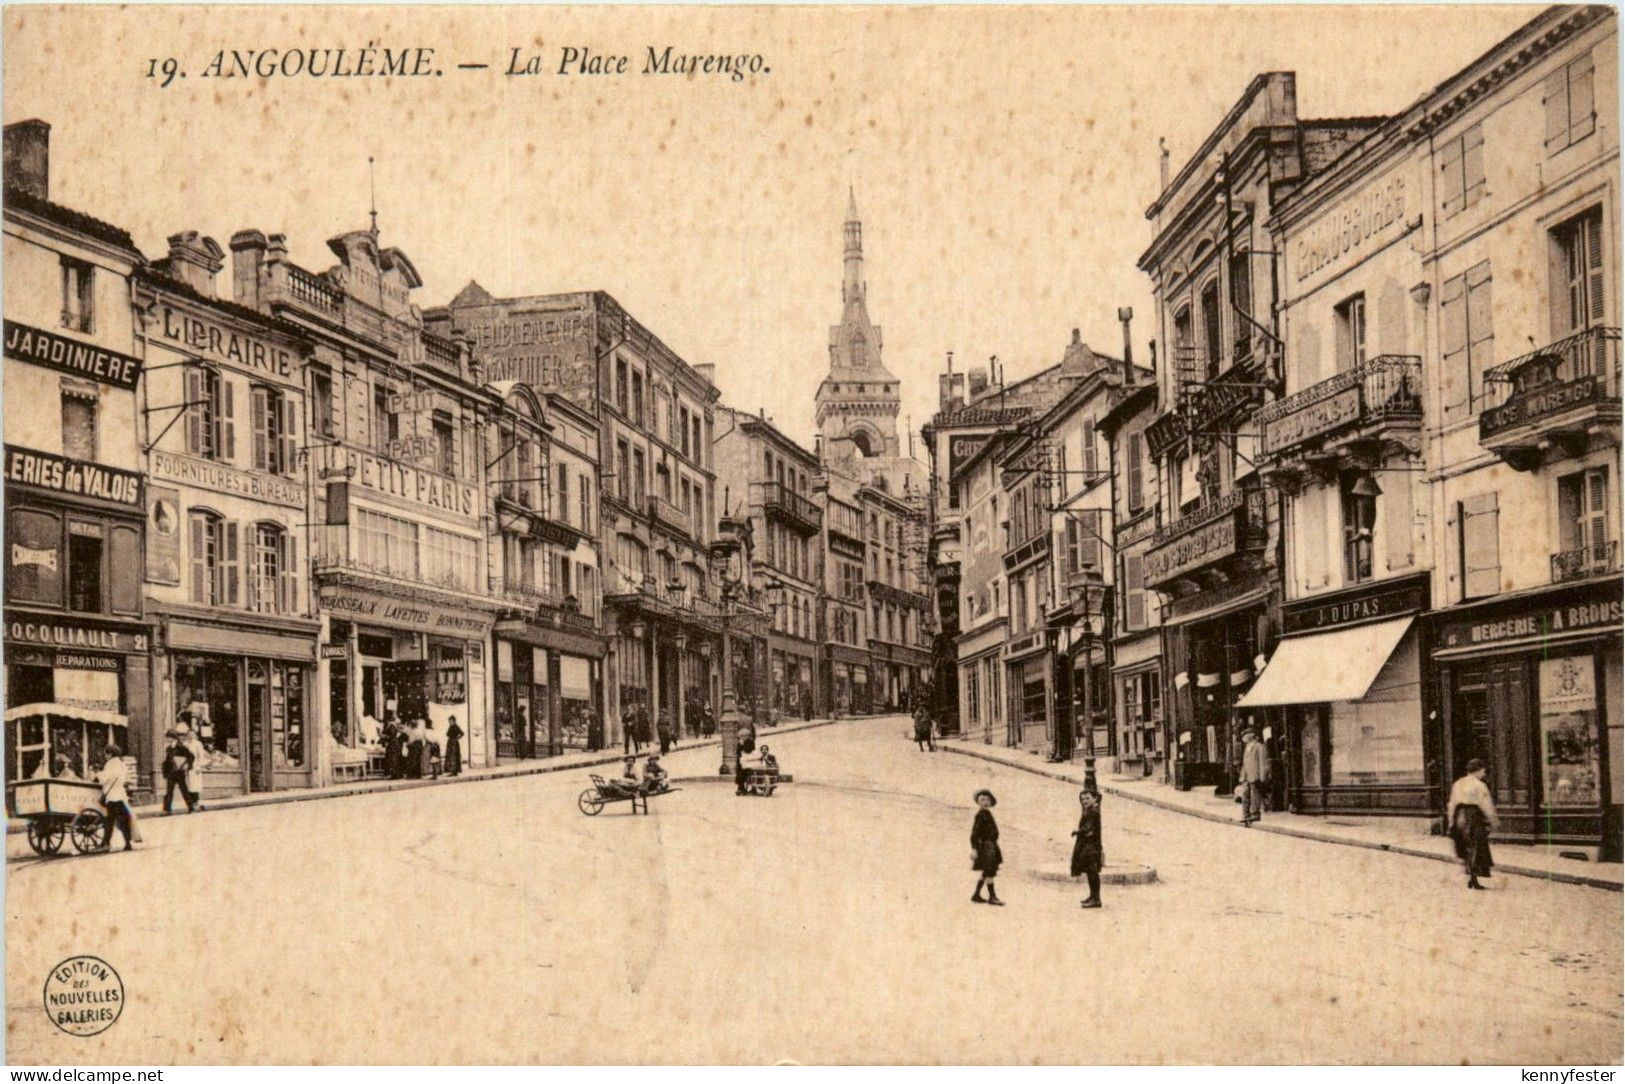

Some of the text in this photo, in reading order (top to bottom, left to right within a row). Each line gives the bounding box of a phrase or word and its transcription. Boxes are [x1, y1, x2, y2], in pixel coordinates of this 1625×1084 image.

[1297, 174, 1405, 282] CHAUSSURES
[6, 327, 136, 384] JARDINIERE
[163, 307, 291, 378] LIBRAIRIE
[390, 438, 439, 460] PARIS
[65, 464, 83, 489] de
[83, 465, 138, 503] VALOIS
[154, 455, 240, 490] FOURNITURES
[416, 471, 474, 515] PARIS
[1331, 598, 1380, 623] DUPAS
[1471, 616, 1537, 642] MERCERIE
[56, 654, 118, 669] REPARATIONS
[55, 961, 110, 984] ÉDITION
[50, 989, 120, 1005] NOUVELLES
[57, 1008, 114, 1025] GALERIES
